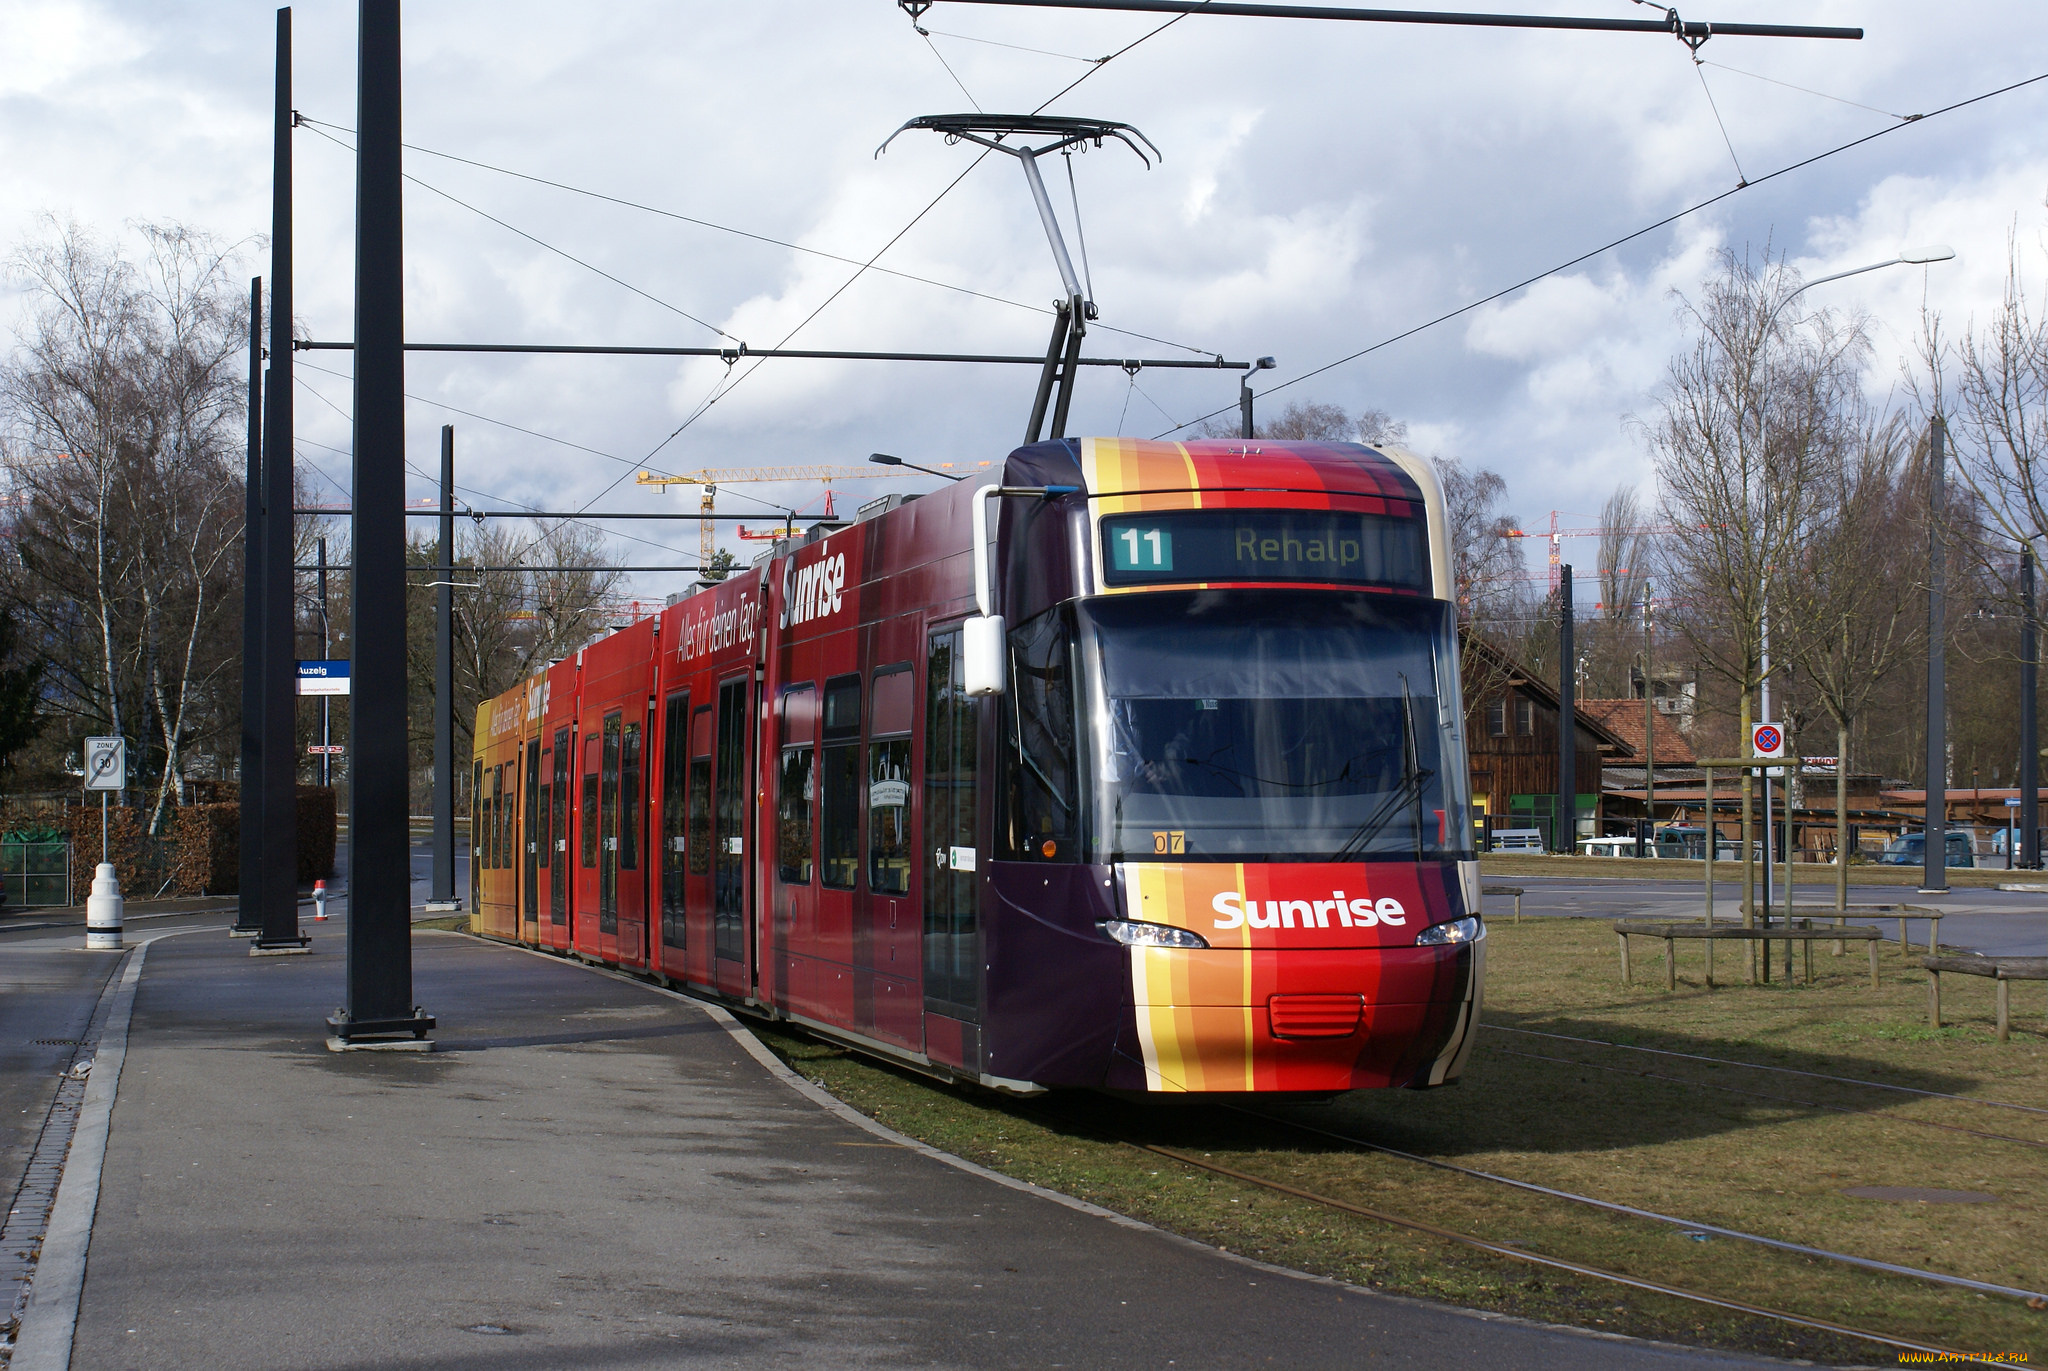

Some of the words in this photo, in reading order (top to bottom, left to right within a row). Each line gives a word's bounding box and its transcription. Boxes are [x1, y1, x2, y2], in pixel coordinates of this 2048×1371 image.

[1120, 527, 1162, 565] 11
[1235, 526, 1360, 567] Rehalp
[779, 540, 845, 630] Sunrise
[677, 612, 696, 664] Alles
[696, 606, 709, 657] für
[709, 599, 737, 653] deinen
[739, 592, 755, 655] Tag.
[297, 666, 327, 676] Auzelg
[99, 758, 111, 769] 30
[1154, 834, 1183, 852] 07
[1211, 890, 1407, 930] Sunrise
